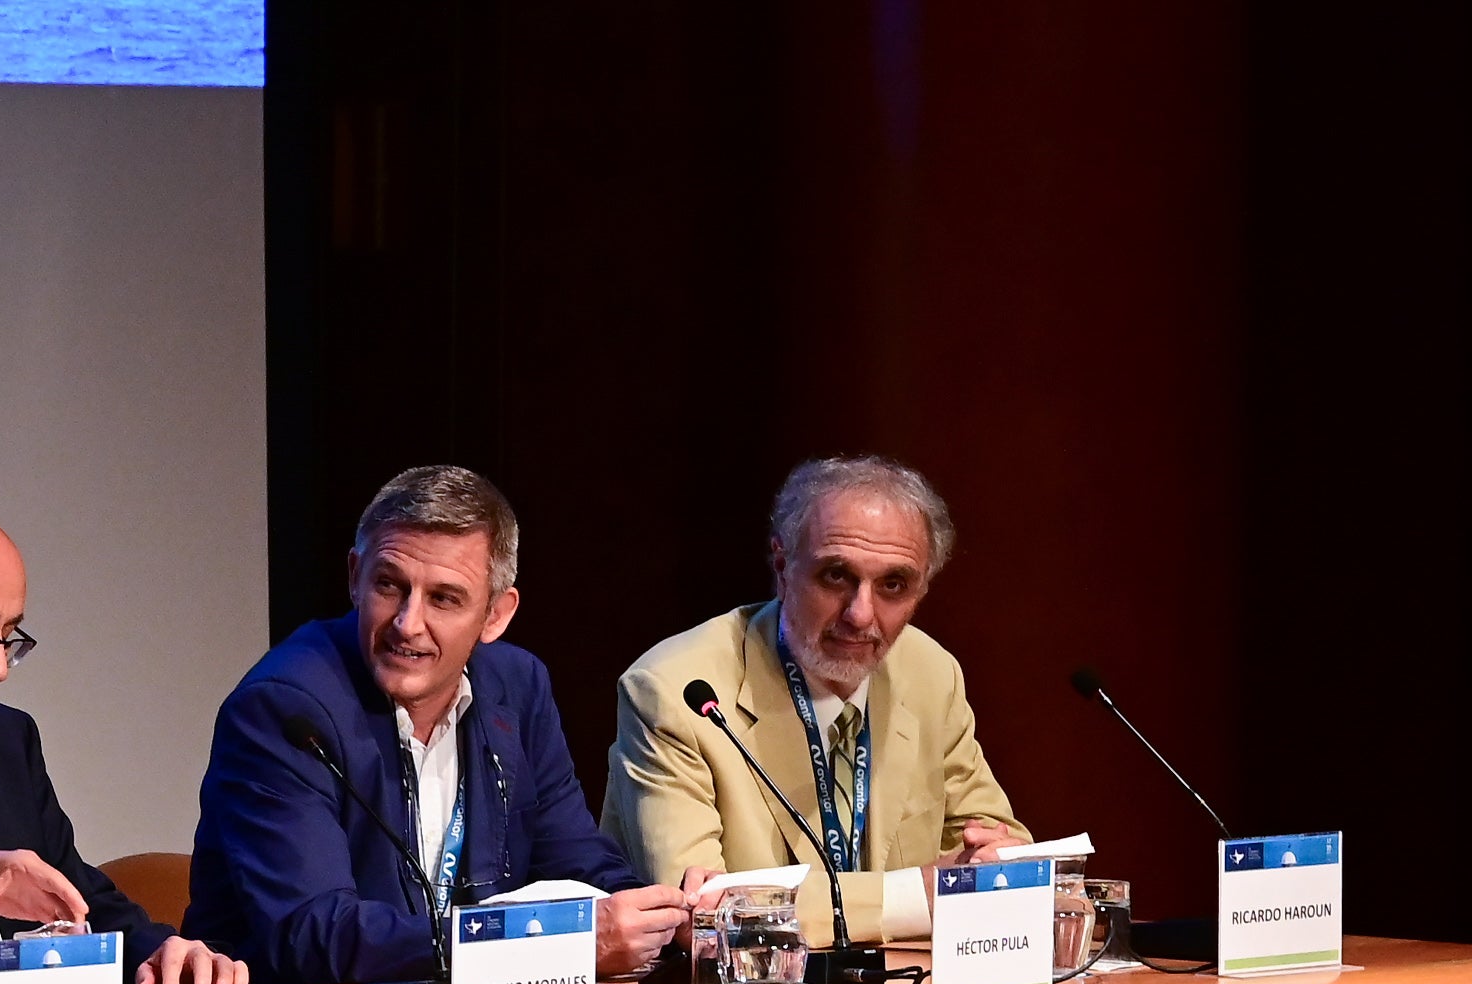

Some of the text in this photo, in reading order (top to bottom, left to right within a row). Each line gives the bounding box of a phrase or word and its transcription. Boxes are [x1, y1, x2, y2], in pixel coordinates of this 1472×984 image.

[794, 684, 814, 730] avantor
[817, 767, 833, 814] avantor
[856, 769, 866, 814] avantor
[1232, 903, 1332, 925] RICARDO HAROUN
[956, 935, 1029, 956] HÉCTOR PULA
